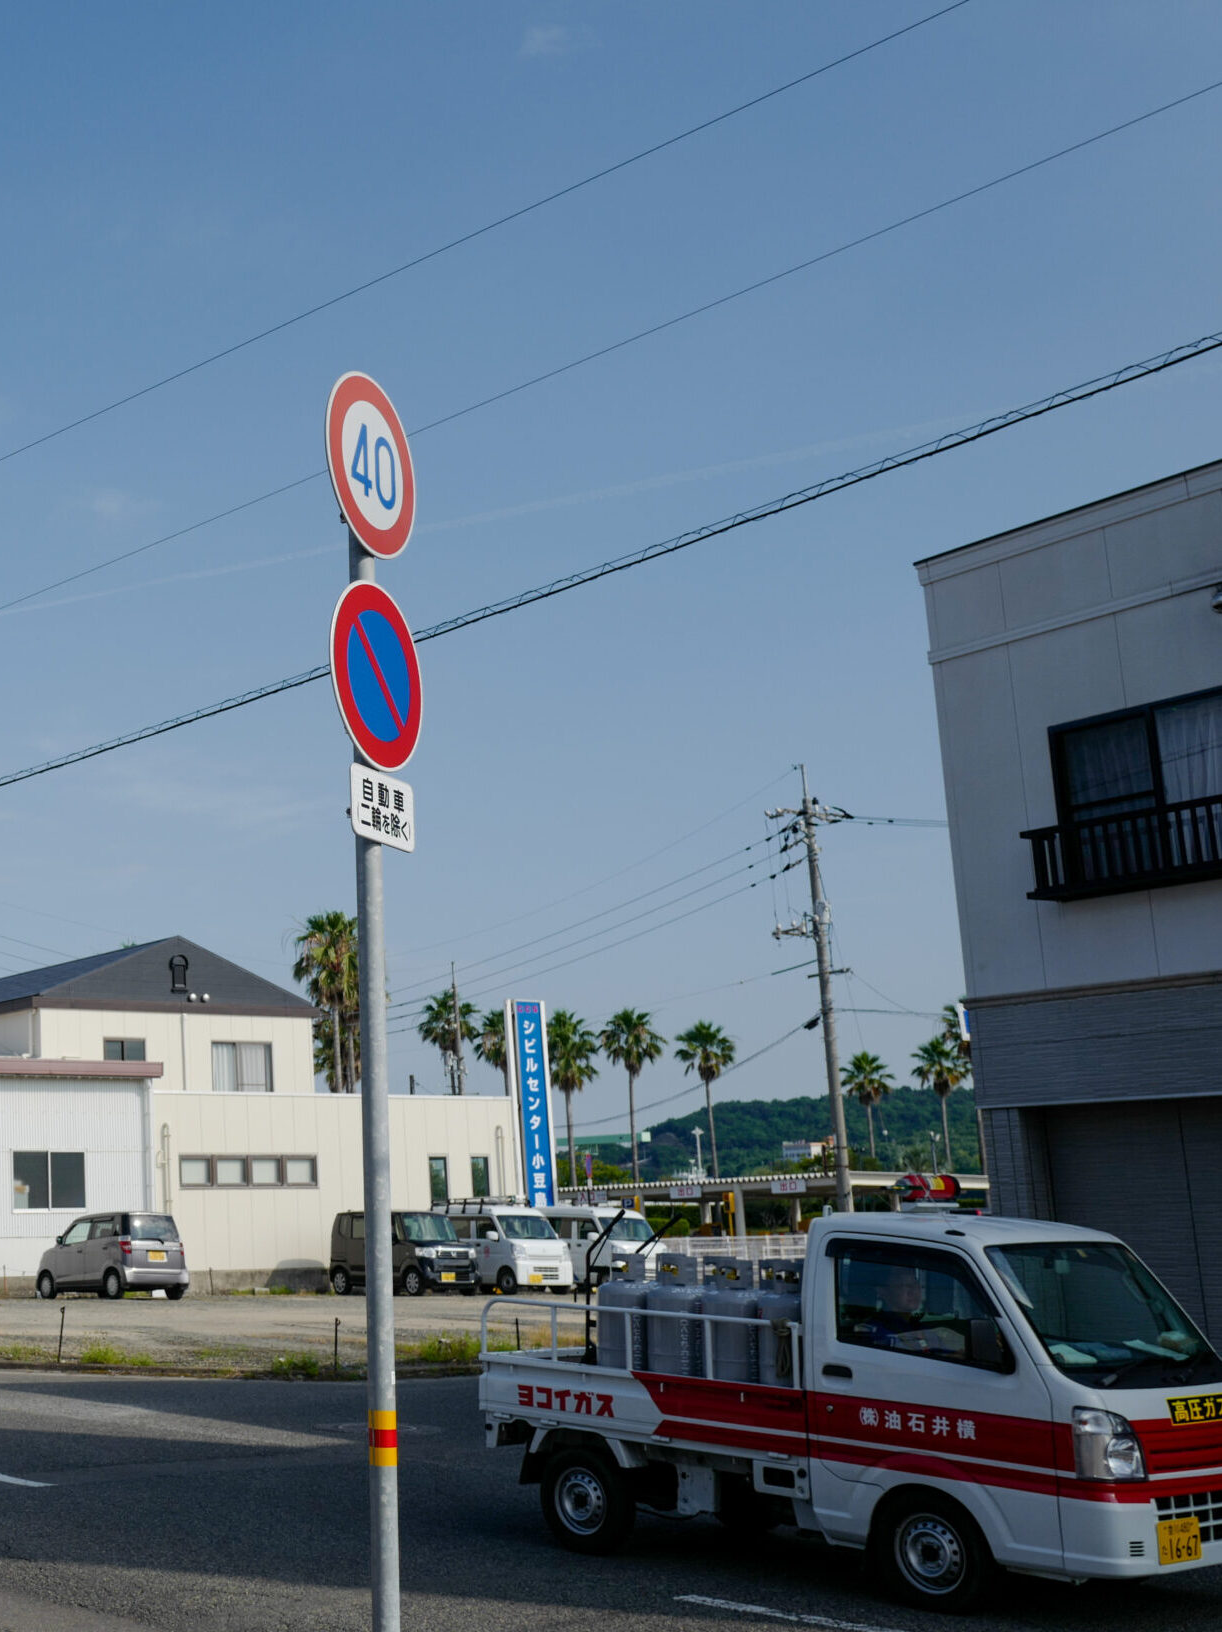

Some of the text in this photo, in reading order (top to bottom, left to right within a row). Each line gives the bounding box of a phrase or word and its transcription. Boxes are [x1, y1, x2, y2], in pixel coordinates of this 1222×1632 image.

[351, 423, 396, 511] 40
[362, 778, 405, 814] 自動車
[678, 1186, 694, 1197] 出口
[780, 1181, 797, 1192] 出口
[517, 1384, 614, 1418] ヨコイガス
